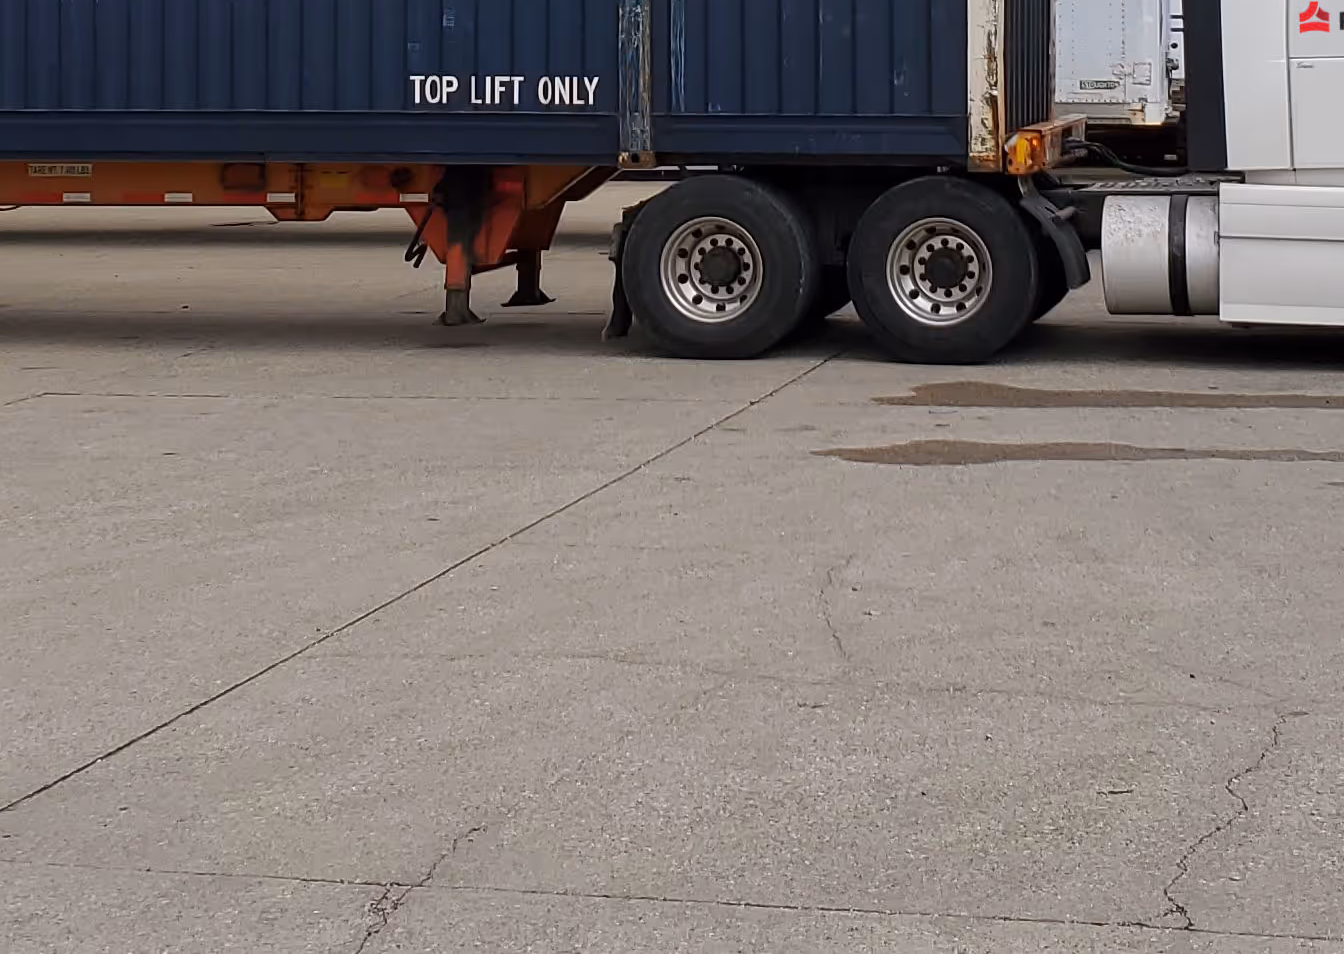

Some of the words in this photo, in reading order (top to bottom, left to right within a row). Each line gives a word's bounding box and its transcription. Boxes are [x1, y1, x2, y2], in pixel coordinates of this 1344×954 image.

[409, 74, 459, 104] TOP
[469, 75, 525, 104] LIFT
[537, 75, 600, 104] ONLY
